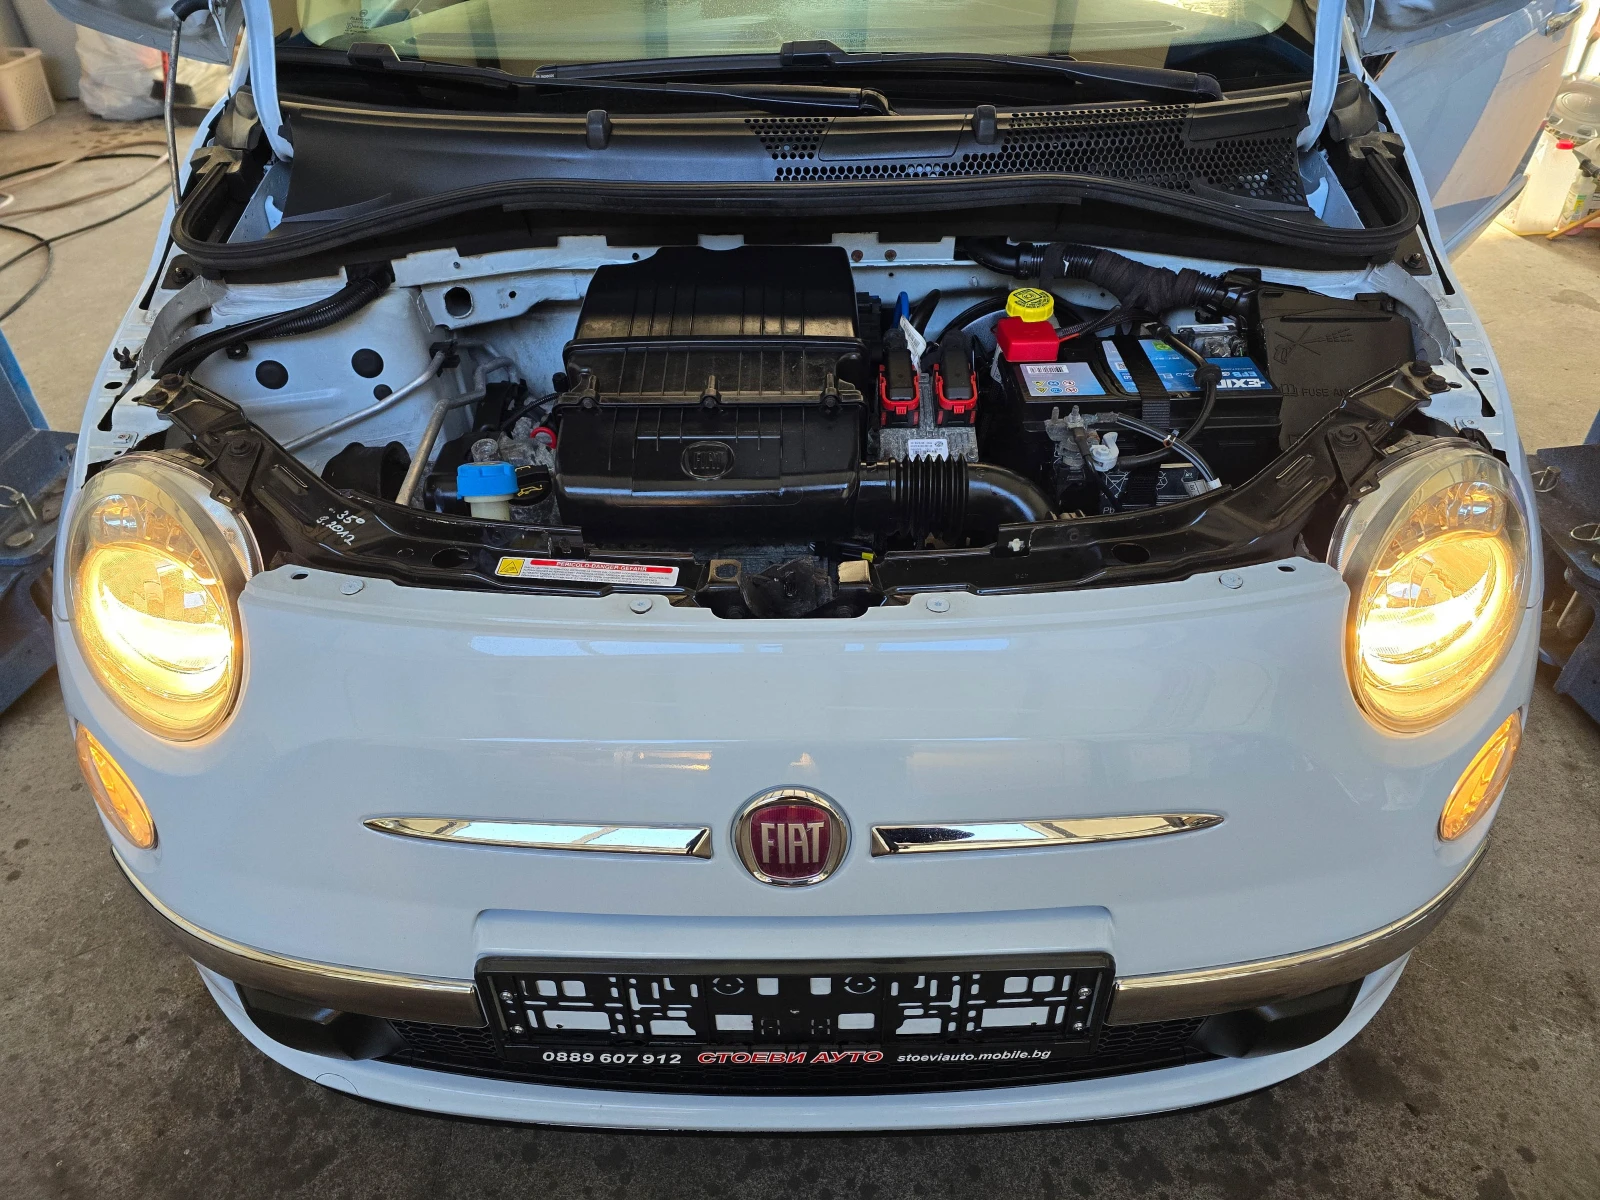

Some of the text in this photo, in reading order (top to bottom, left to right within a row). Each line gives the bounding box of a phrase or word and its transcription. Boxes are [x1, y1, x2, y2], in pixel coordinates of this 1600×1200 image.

[1301, 388, 1329, 397] FUSE
[760, 821, 825, 864] FIAT
[542, 1051, 682, 1064] 0889 607 912
[697, 1051, 884, 1064] СТОЕВИ АУТО
[896, 1050, 1052, 1062] stoeviauto.mobile.bg
